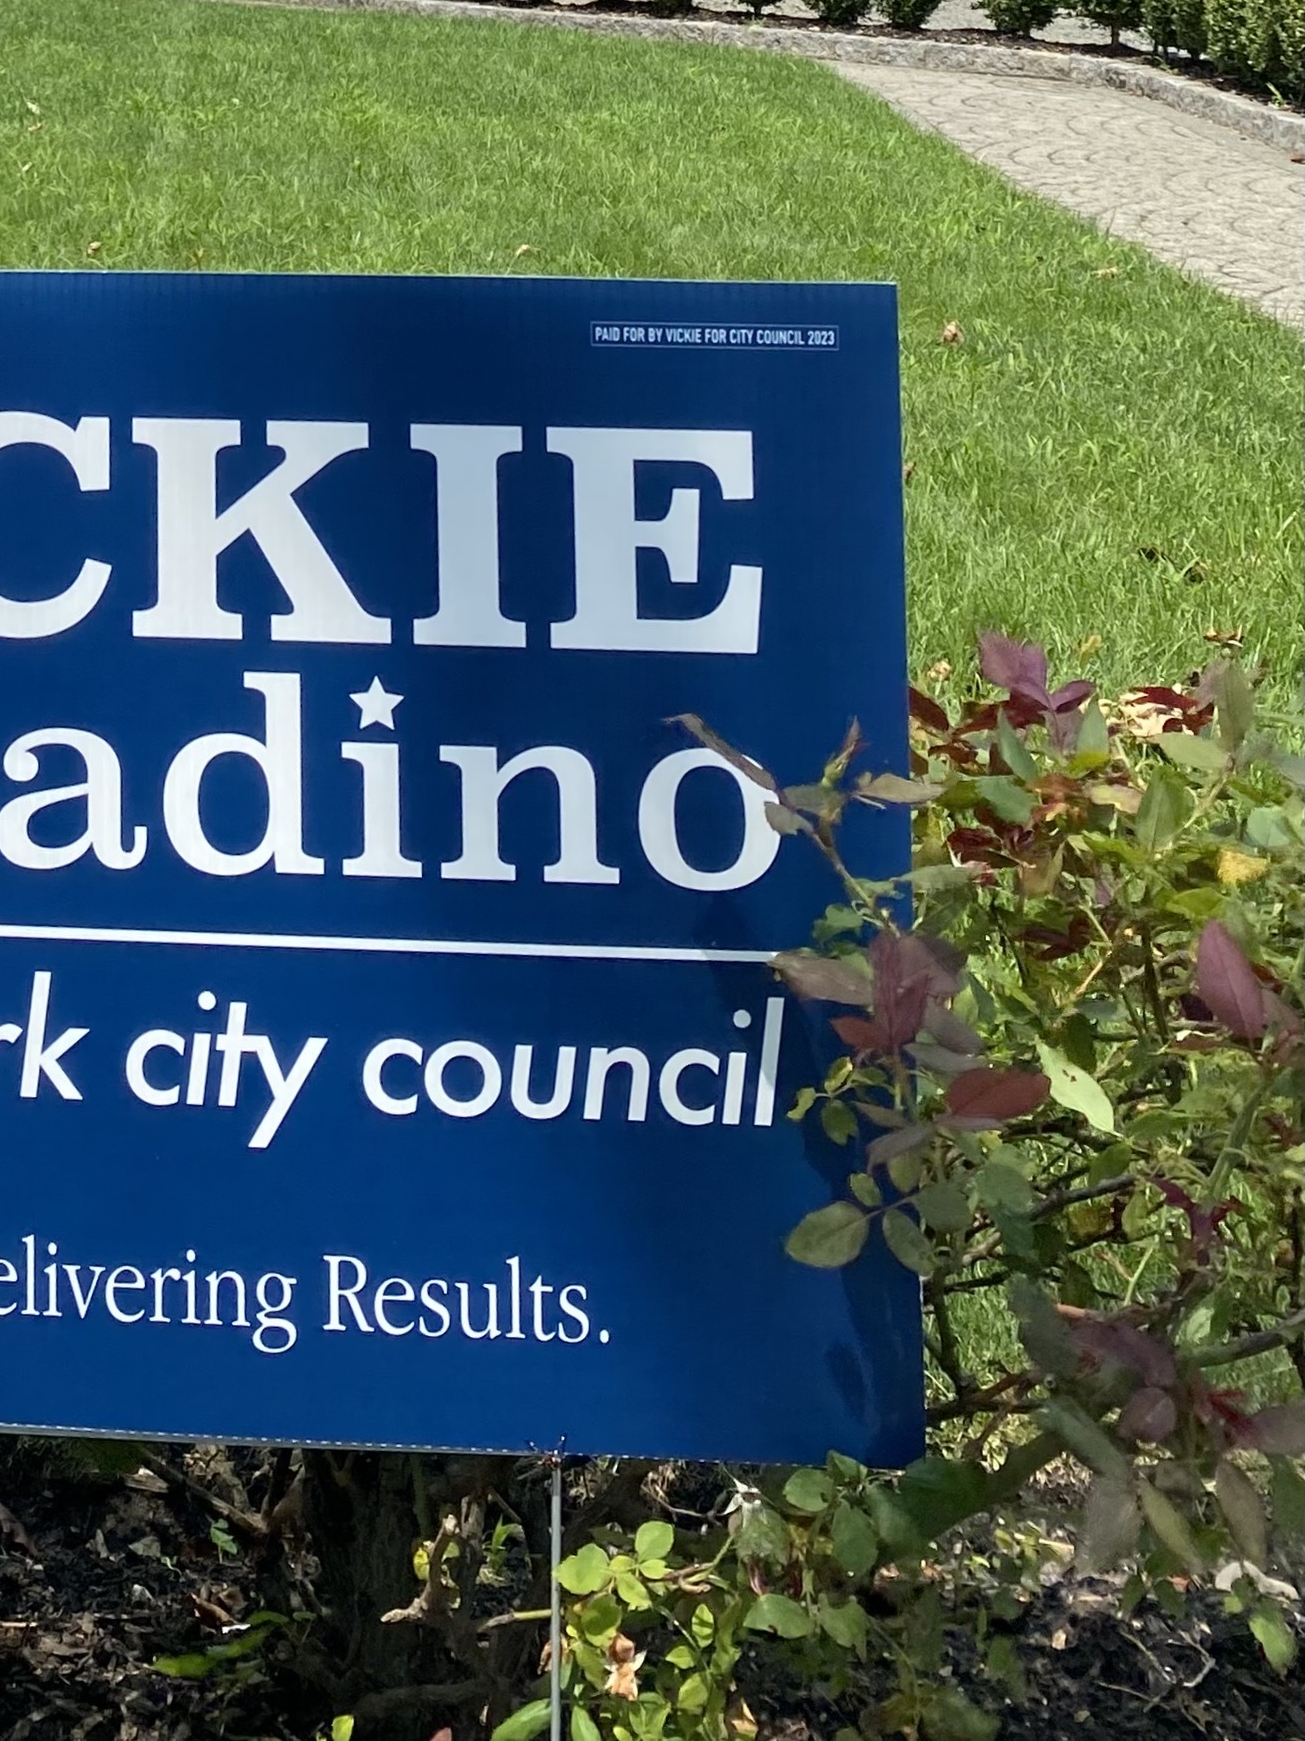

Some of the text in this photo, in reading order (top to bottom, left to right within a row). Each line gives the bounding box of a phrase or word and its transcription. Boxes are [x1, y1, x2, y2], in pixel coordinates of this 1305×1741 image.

[595, 326, 835, 345] PAID FOR BY VICKIE FOR CITY COUNCIL 2023
[126, 990, 328, 1148] city
[363, 998, 784, 1126] council
[322, 1255, 610, 1344] Results.
